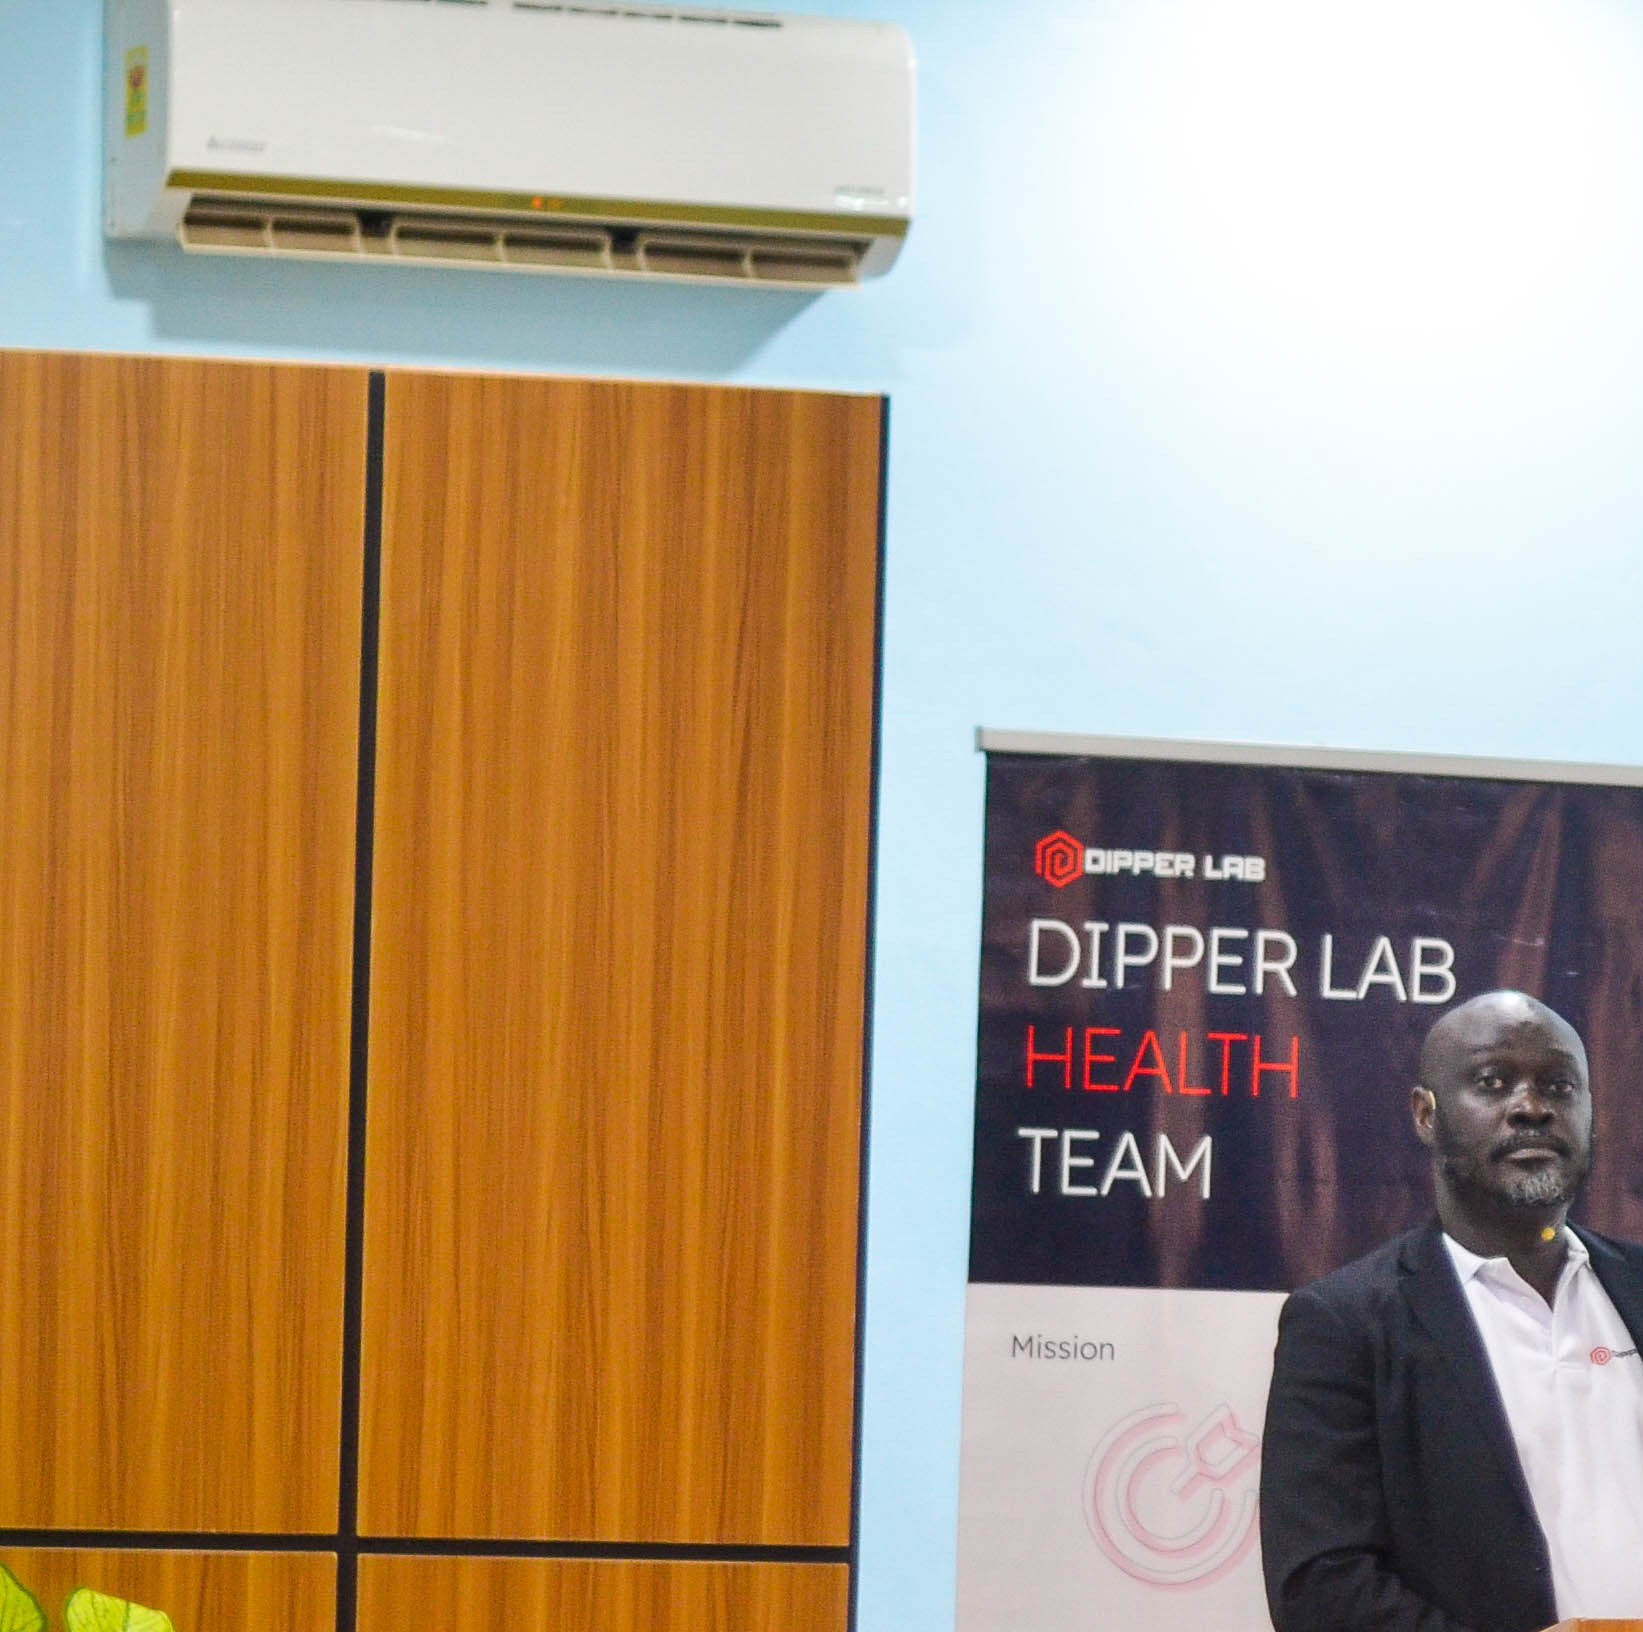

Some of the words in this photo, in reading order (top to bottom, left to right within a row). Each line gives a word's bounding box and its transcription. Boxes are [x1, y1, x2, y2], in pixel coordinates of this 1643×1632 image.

[1085, 848, 1195, 879] DIPPER
[1204, 855, 1266, 882] LAB
[1028, 919, 1299, 998] DIPPER
[1320, 935, 1458, 1005] LAB
[1025, 1025, 1300, 1099] HEALTH
[1019, 1128, 1212, 1199] TEAM
[1011, 1335, 1114, 1362] Mission
